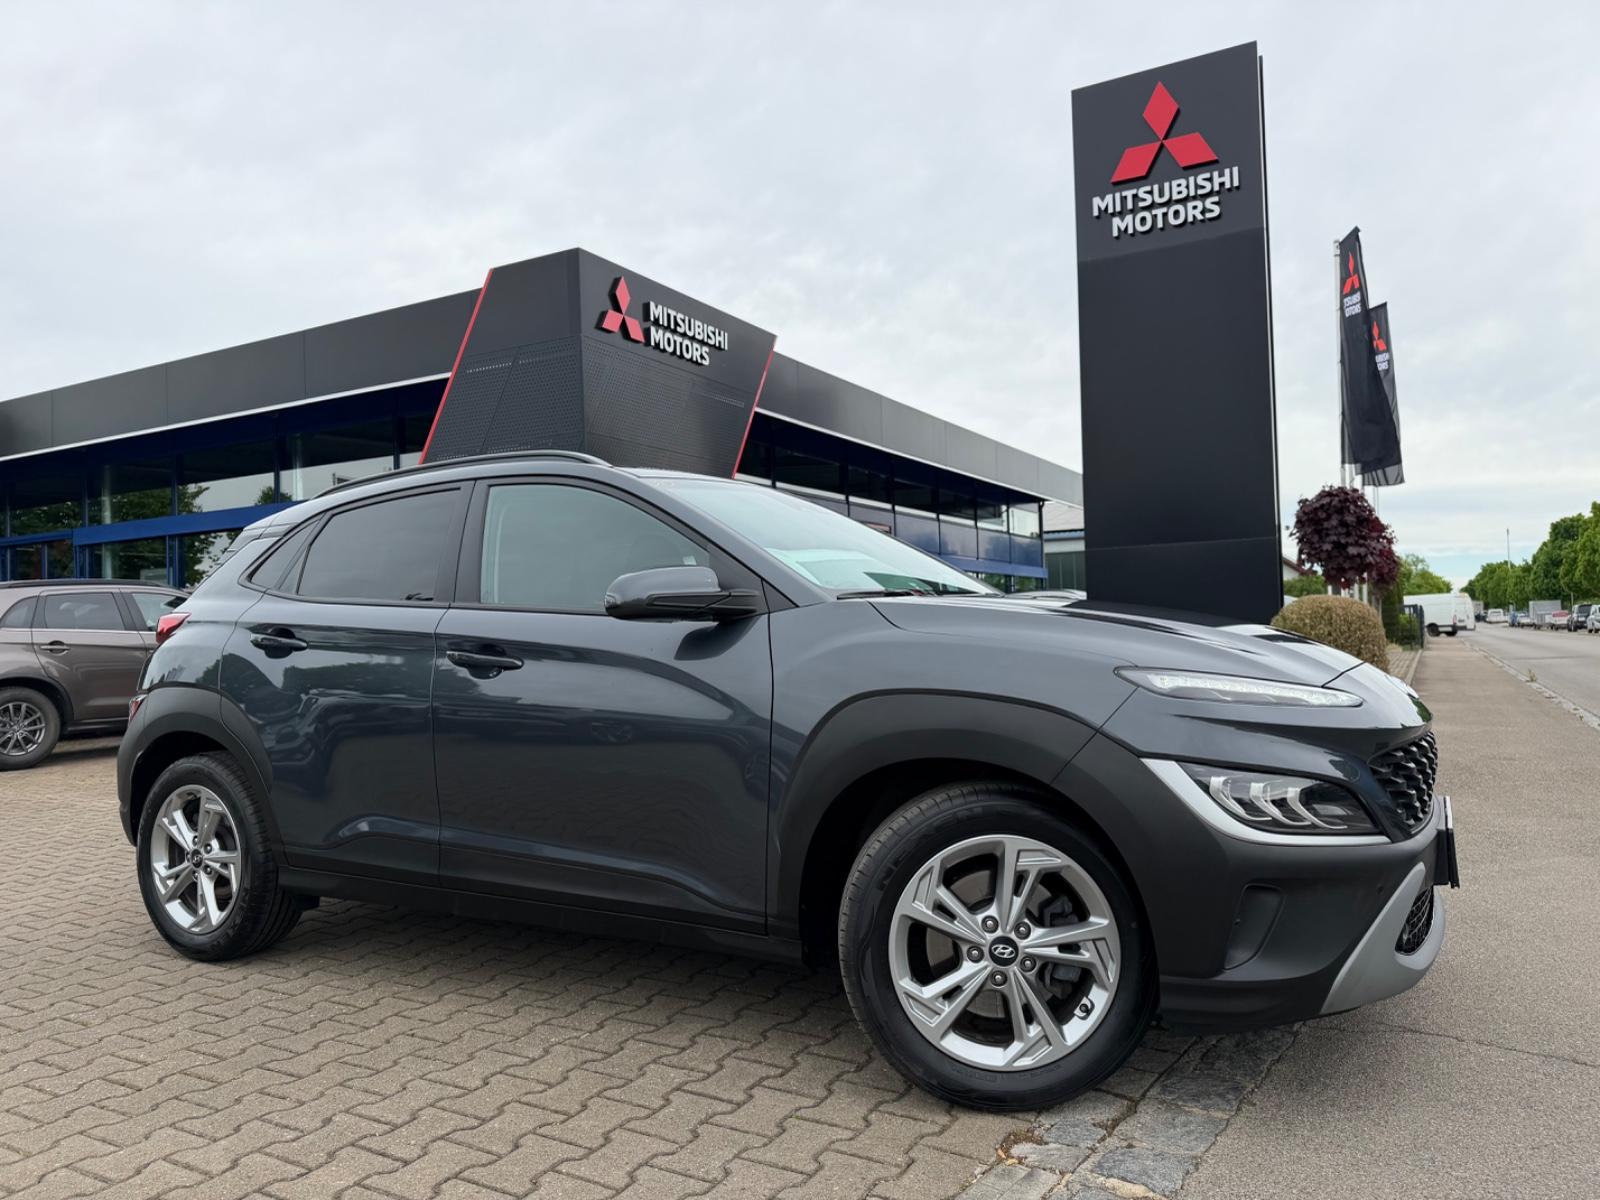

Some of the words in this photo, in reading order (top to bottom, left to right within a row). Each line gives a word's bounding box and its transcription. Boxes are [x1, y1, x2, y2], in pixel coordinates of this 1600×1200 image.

[1092, 166, 1240, 217] MITSUBISHI
[1112, 196, 1221, 238] MOTORS
[649, 301, 729, 351] MITSUBISHI
[649, 326, 710, 366] MOTORS
